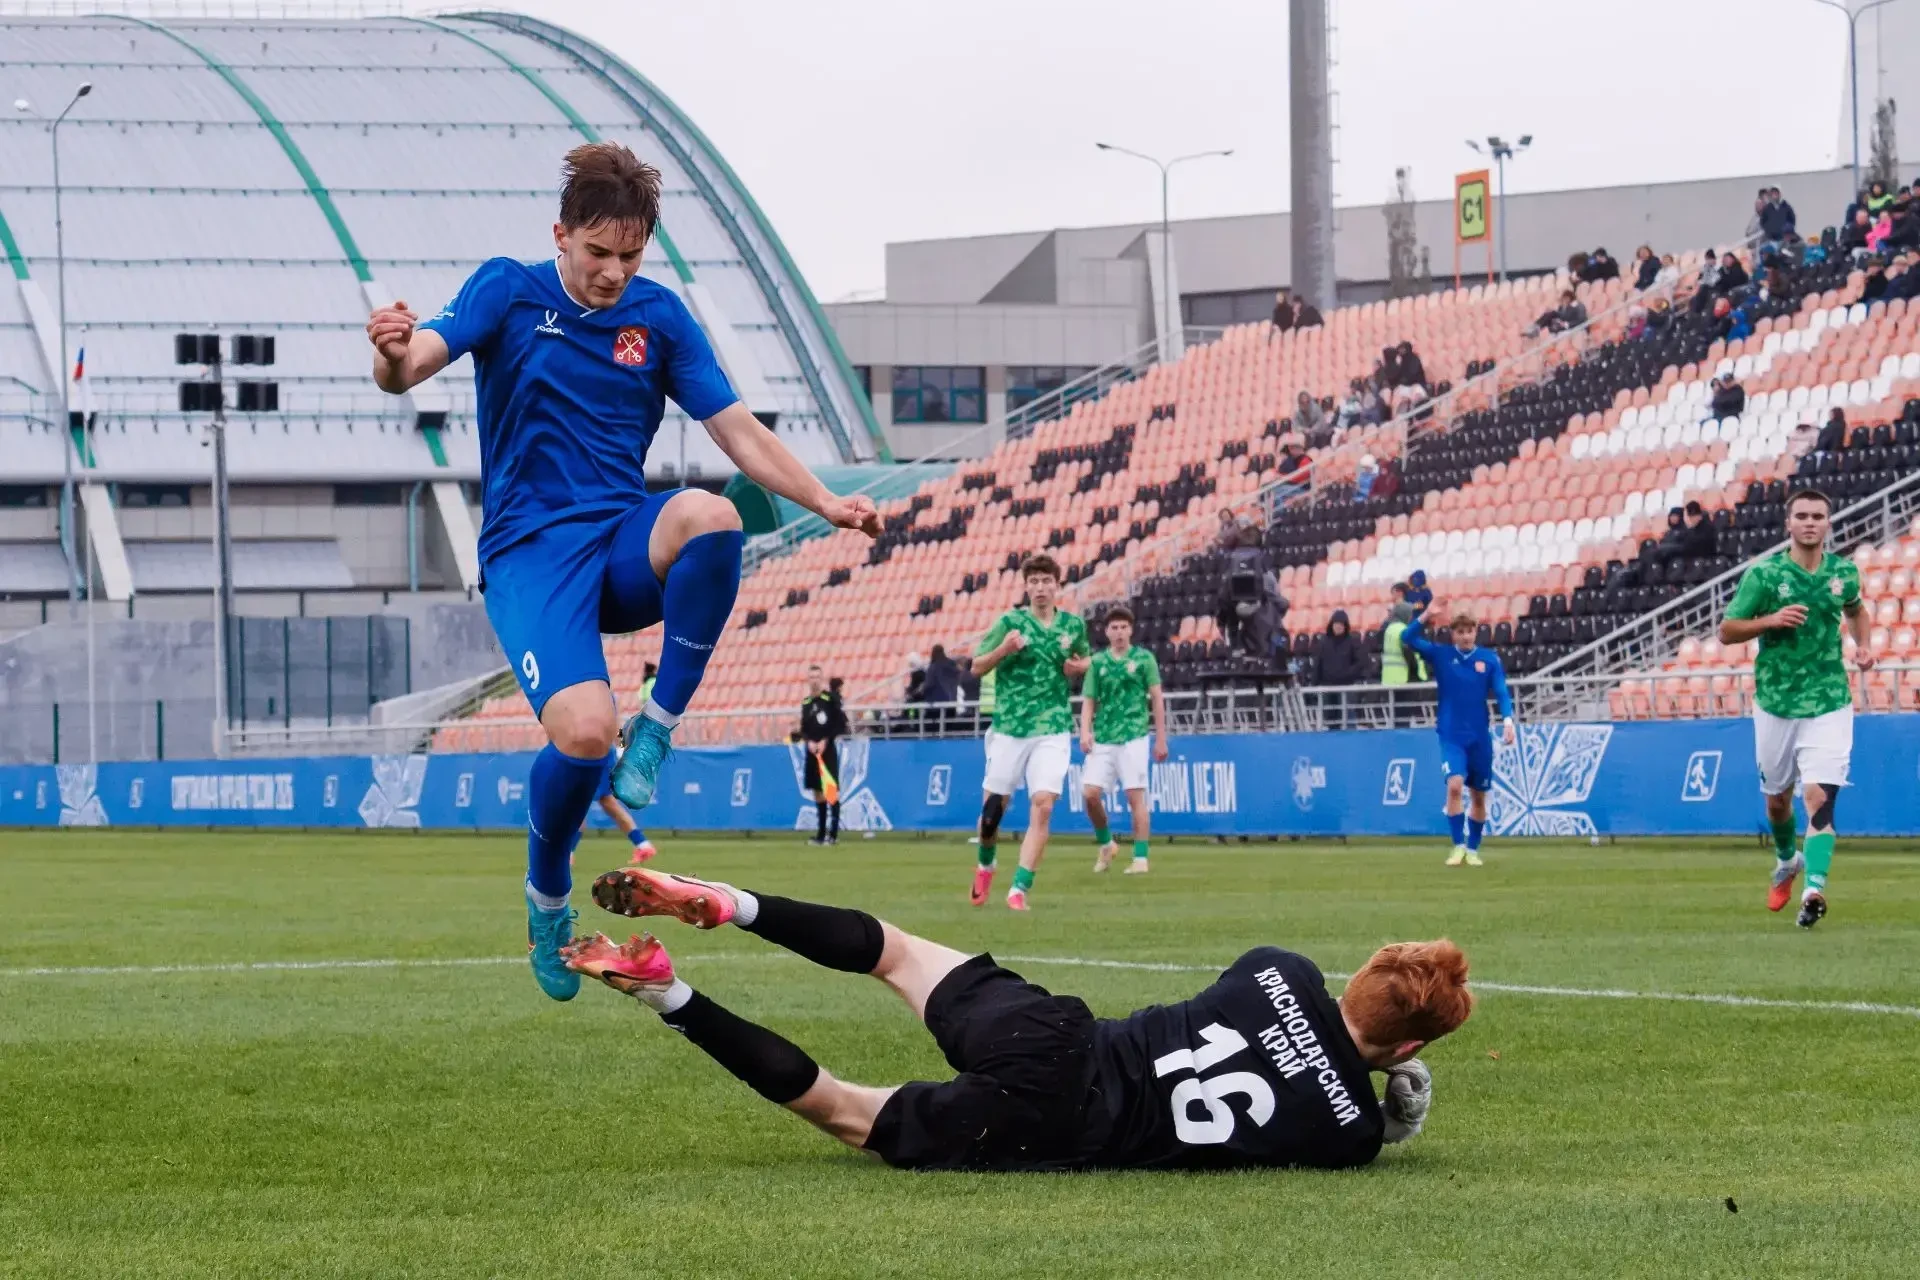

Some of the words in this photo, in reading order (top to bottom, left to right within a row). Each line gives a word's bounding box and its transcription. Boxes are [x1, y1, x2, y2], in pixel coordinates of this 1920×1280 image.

[522, 650, 540, 690] 9
[1193, 762, 1237, 812] ЦЕЛИ
[1254, 967, 1361, 1127] КРАСНОДАРСКИЙ
[1258, 1023, 1307, 1079] КРАЙ
[1153, 1022, 1276, 1145] 16
